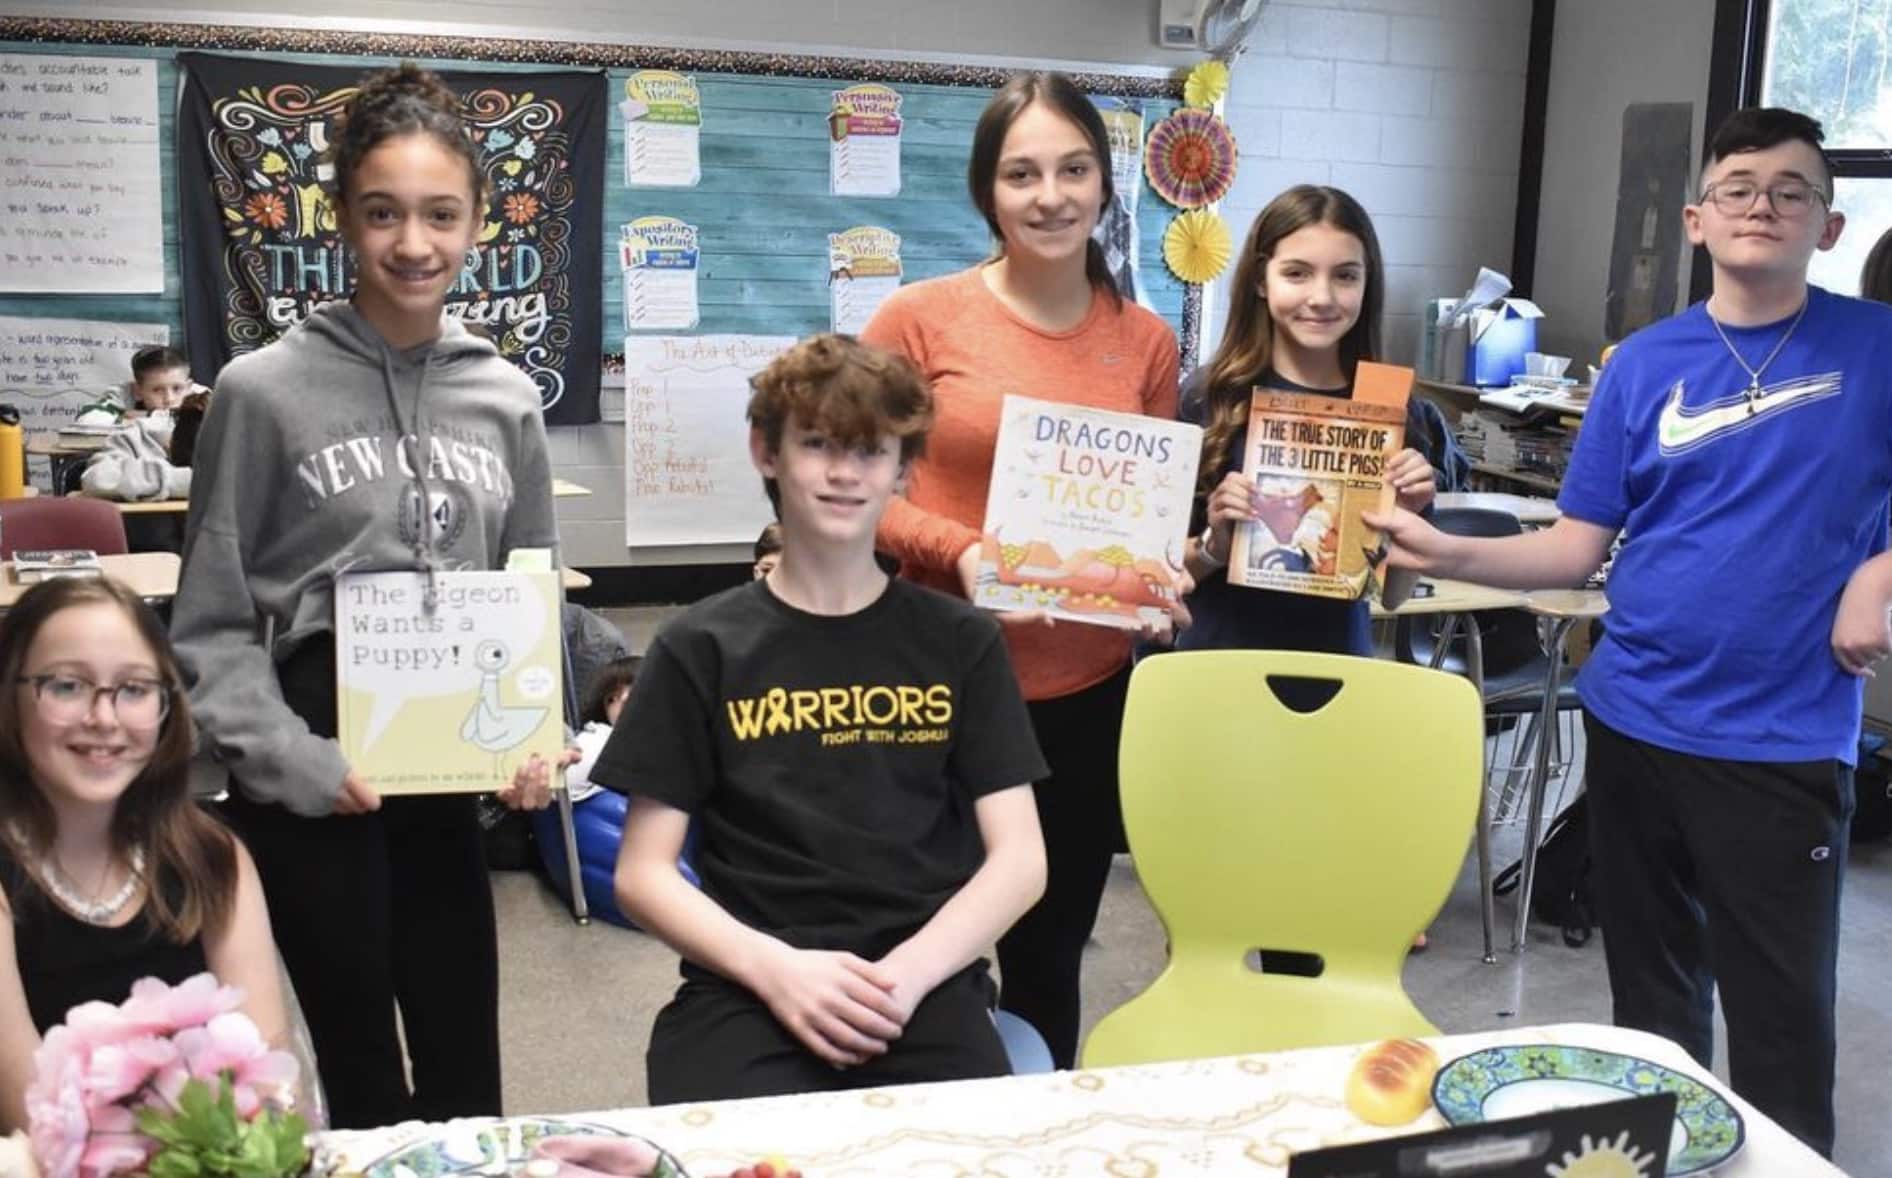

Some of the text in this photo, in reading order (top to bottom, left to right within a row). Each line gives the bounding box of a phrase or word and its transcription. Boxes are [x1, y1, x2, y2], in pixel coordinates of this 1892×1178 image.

[622, 222, 696, 239] Expository
[646, 235, 695, 250] Writing
[261, 243, 543, 294] THI RLD
[1036, 415, 1172, 464] DRAGONS
[1261, 418, 1389, 452] THE TRUE STORY OF
[297, 435, 385, 509] NEW
[1059, 449, 1139, 487] LOVE
[1258, 443, 1386, 478] THE 3 LITTLE PIGS!
[1040, 474, 1146, 519] TACOS
[350, 582, 407, 606] The
[352, 613, 476, 635] Wants a
[352, 644, 460, 671] Puppy!
[821, 729, 861, 747] FIGHT
[865, 728, 896, 743] WITH
